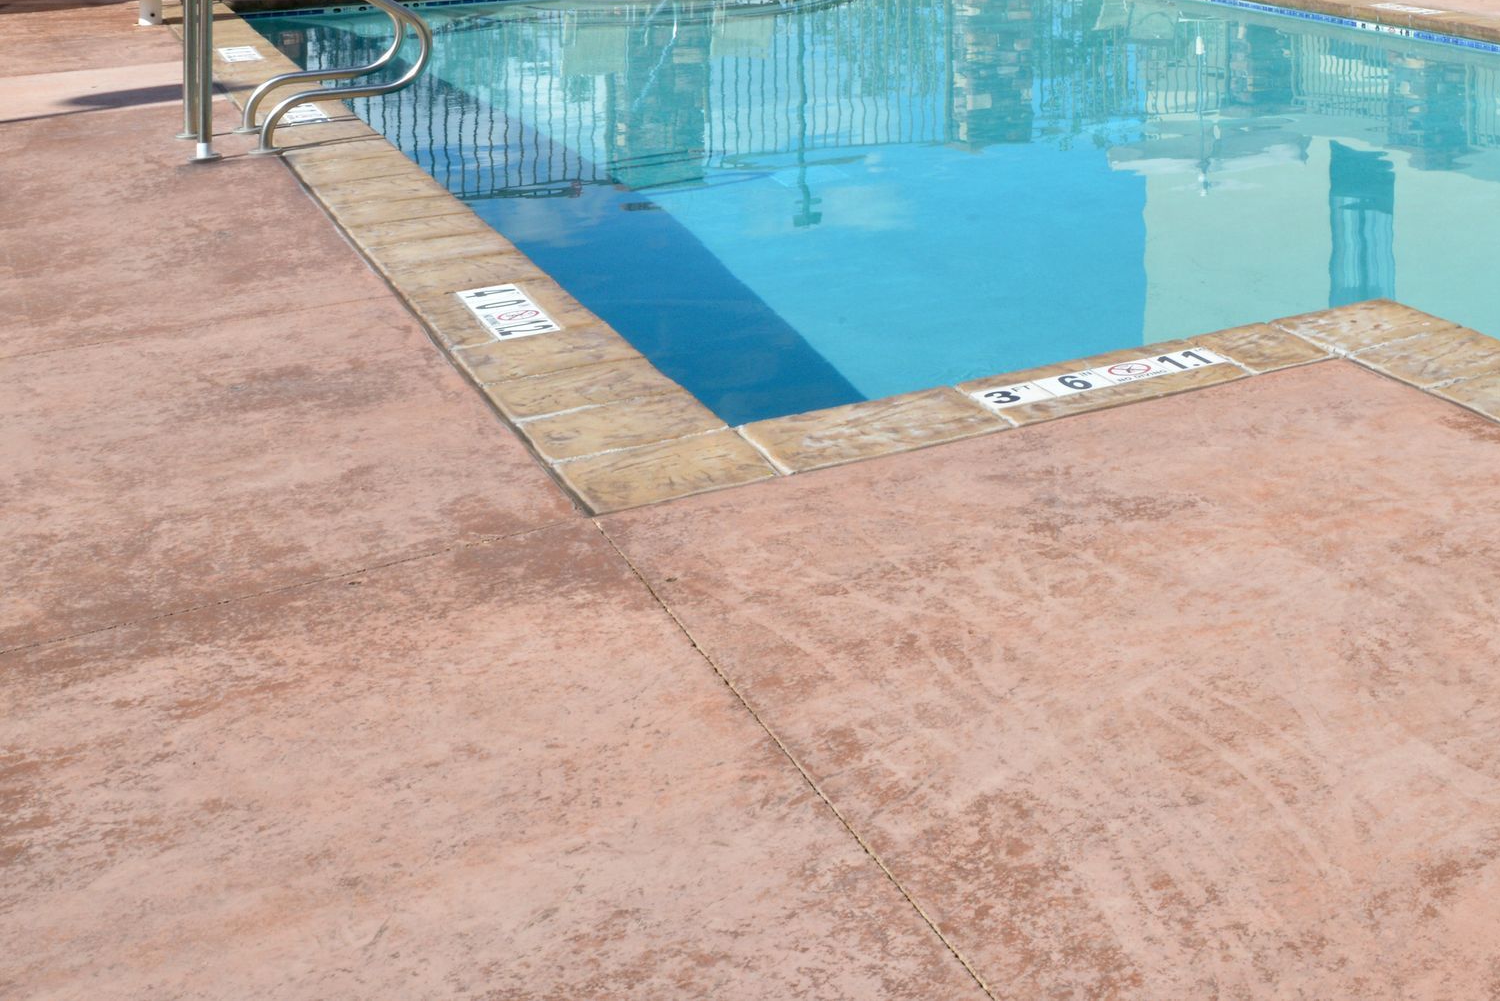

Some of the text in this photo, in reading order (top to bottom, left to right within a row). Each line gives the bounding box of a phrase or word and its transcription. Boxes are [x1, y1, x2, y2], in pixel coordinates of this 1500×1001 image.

[983, 390, 1021, 405] 3
[1011, 384, 1031, 393] FT
[1057, 375, 1093, 390] 6
